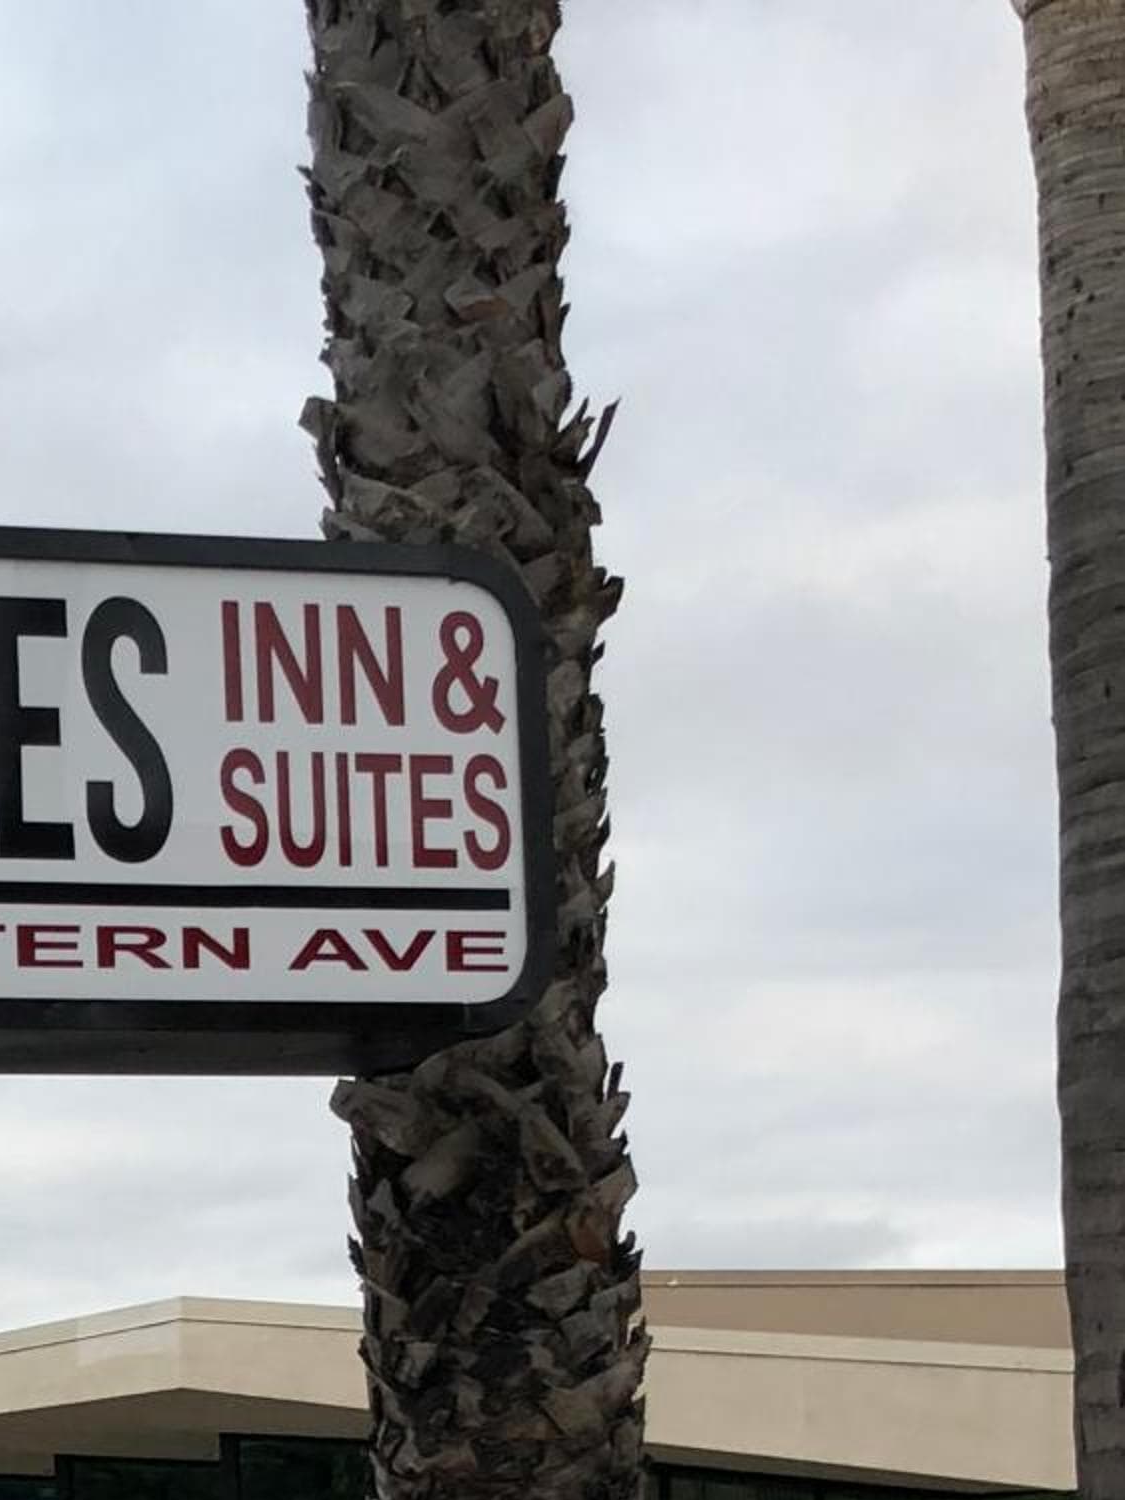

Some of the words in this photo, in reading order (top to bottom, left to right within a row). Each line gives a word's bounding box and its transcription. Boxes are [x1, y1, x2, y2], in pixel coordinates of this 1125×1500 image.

[221, 601, 405, 727] INN
[431, 611, 507, 735] &
[220, 748, 512, 871] SUITES
[288, 929, 510, 972] AVE
